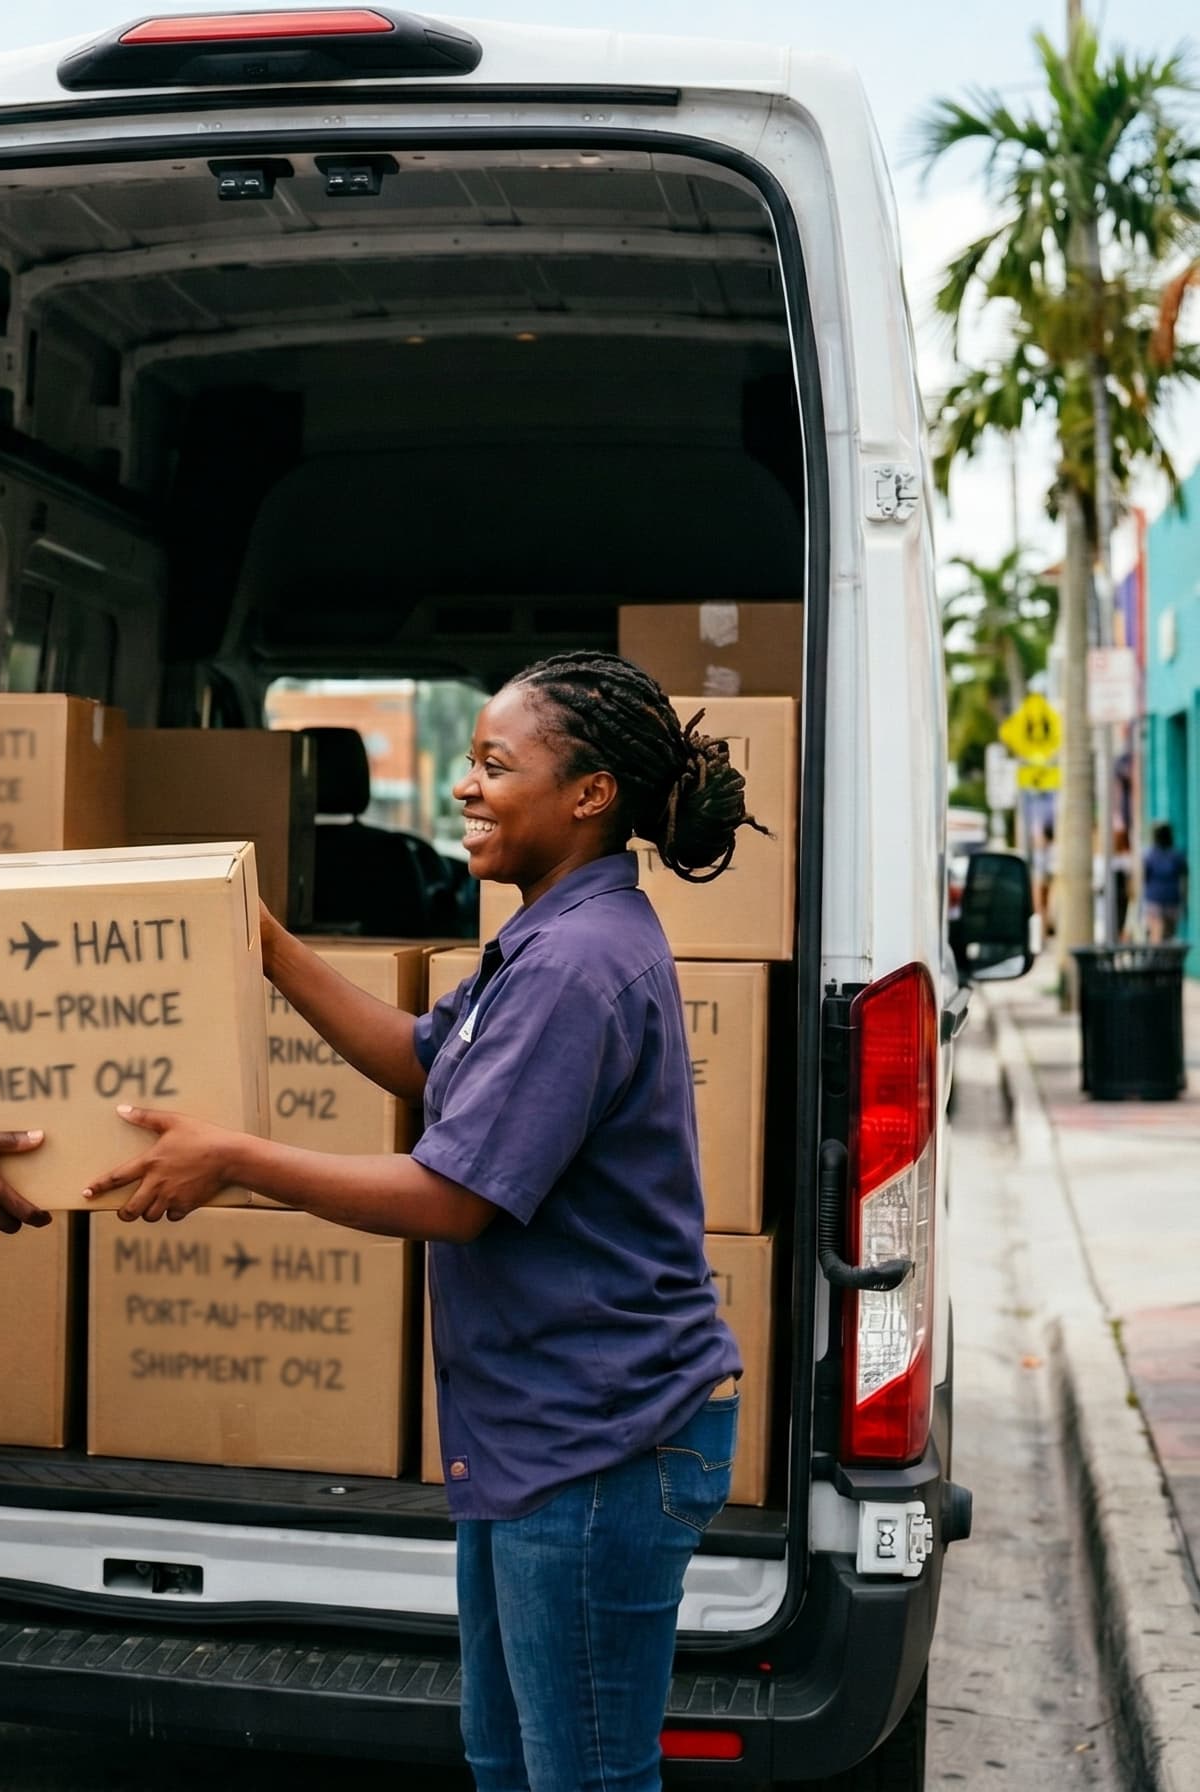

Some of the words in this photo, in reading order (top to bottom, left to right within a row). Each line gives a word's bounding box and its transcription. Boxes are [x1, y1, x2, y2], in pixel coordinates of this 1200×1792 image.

[94, 1056, 178, 1098] 042
[275, 1087, 338, 1120] 042
[114, 1238, 211, 1275] MIAMI
[271, 1246, 362, 1285] HAITI
[125, 1295, 354, 1336] PORT-AU-PRINCE
[129, 1349, 268, 1386] SHIPMENT
[279, 1359, 346, 1392] 042
